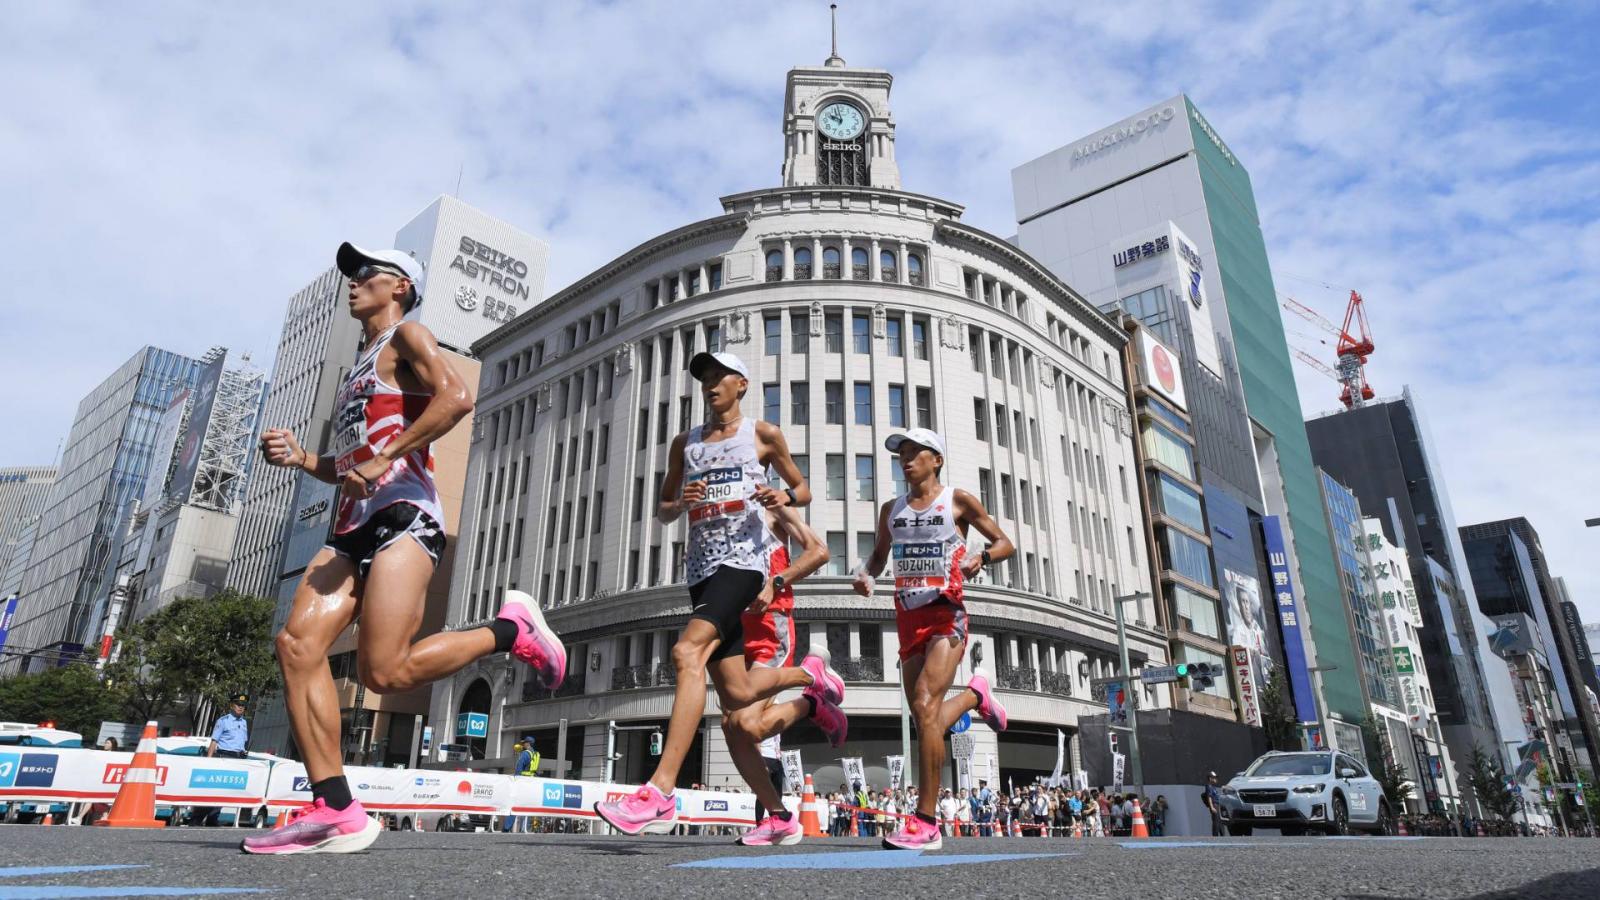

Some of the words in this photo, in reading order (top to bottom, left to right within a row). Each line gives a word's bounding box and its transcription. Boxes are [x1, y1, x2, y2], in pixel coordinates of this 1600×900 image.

[1075, 106, 1176, 161] MIKIMOTO
[823, 143, 862, 151] SEIKO
[459, 235, 528, 279] SEIKO
[1113, 235, 1170, 268] 山野楽器
[449, 254, 530, 301] ASTRON
[484, 295, 517, 317] GPS
[893, 515, 945, 528] 富士通
[897, 559, 935, 572] SUZUKI
[1270, 552, 1297, 626] 山野楽器
[1394, 651, 1411, 669] 本
[21, 766, 53, 774] 東京メトロ
[208, 774, 246, 785] ANESSA
